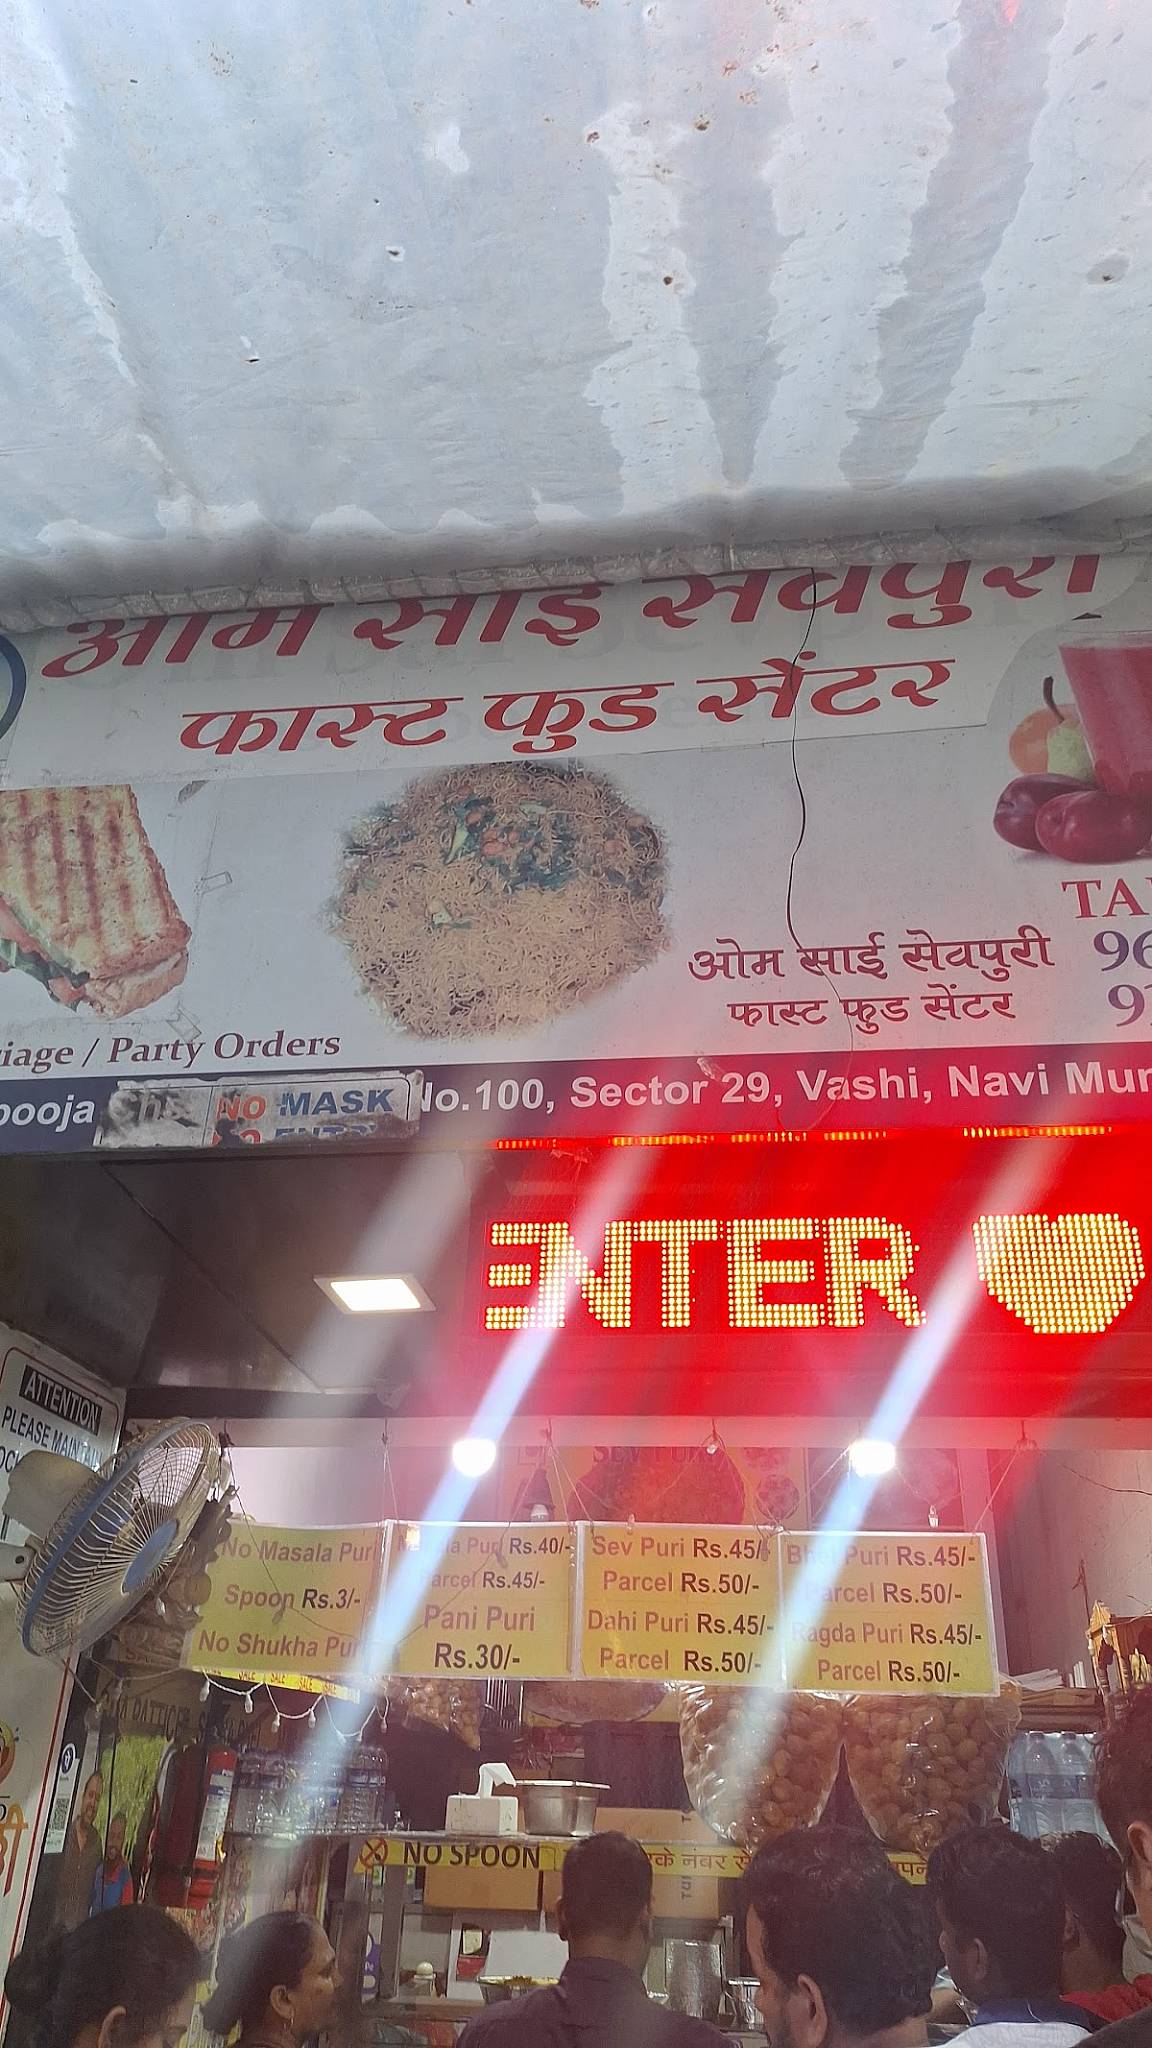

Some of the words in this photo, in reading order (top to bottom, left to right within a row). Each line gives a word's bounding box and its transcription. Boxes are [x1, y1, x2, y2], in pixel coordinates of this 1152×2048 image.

[180, 697, 464, 755] फास्ट
[484, 681, 675, 754] फुड
[696, 651, 956, 722] सेंटर
[1061, 877, 1152, 919] TA
[687, 937, 785, 981] ओम
[796, 931, 889, 979] साई
[897, 924, 1056, 982] सेवपुरी
[726, 999, 829, 1027] फास्ट
[838, 996, 910, 1035] फुड
[920, 982, 1017, 1021] सेंटर
[0, 1041, 74, 1074] iage
[107, 1035, 205, 1068] Party
[213, 1030, 342, 1060] Orders
[570, 1074, 709, 1108] Sector
[721, 1070, 783, 1107] 29,
[796, 1066, 933, 1103] Vashi,
[948, 1062, 1050, 1098] Navi
[215, 1096, 267, 1122] NO
[280, 1087, 394, 1117] MASK
[24, 1370, 99, 1432] ATTENTION
[2, 1405, 51, 1448] PLEASE
[223, 1537, 251, 1558] No
[260, 1538, 332, 1563] Masala
[509, 1536, 571, 1555] Rs.40/-
[592, 1535, 633, 1557] Sev
[640, 1536, 686, 1558] Puri
[692, 1537, 771, 1560] Rs.45/-
[845, 1545, 890, 1567] Puri
[896, 1546, 977, 1568] Rs.45/-
[482, 1571, 546, 1590] Rs.45/-
[604, 1569, 674, 1592] Parcel
[680, 1572, 760, 1595] Rs.50/-
[882, 1581, 963, 1604] Rs.50/-
[224, 1584, 297, 1611] Spoon
[301, 1587, 361, 1611] Rs.3/-
[424, 1604, 477, 1631] Pani
[486, 1605, 536, 1632] Puri
[588, 1609, 637, 1631] Dahi
[645, 1610, 690, 1634] Puri
[697, 1612, 774, 1636] Rs.45/-
[200, 1631, 230, 1654] No
[236, 1632, 319, 1659] Shukha
[862, 1622, 904, 1645] Puri
[911, 1622, 983, 1645] Rs.45/-
[434, 1641, 521, 1670] Rs.30/-
[600, 1647, 670, 1671] Parcel
[684, 1649, 762, 1673] Rs.50/-
[818, 1658, 882, 1682] Parcel
[888, 1659, 961, 1683] Rs.50/-
[404, 1841, 442, 1865] NO
[450, 1842, 540, 1869] SPOON
